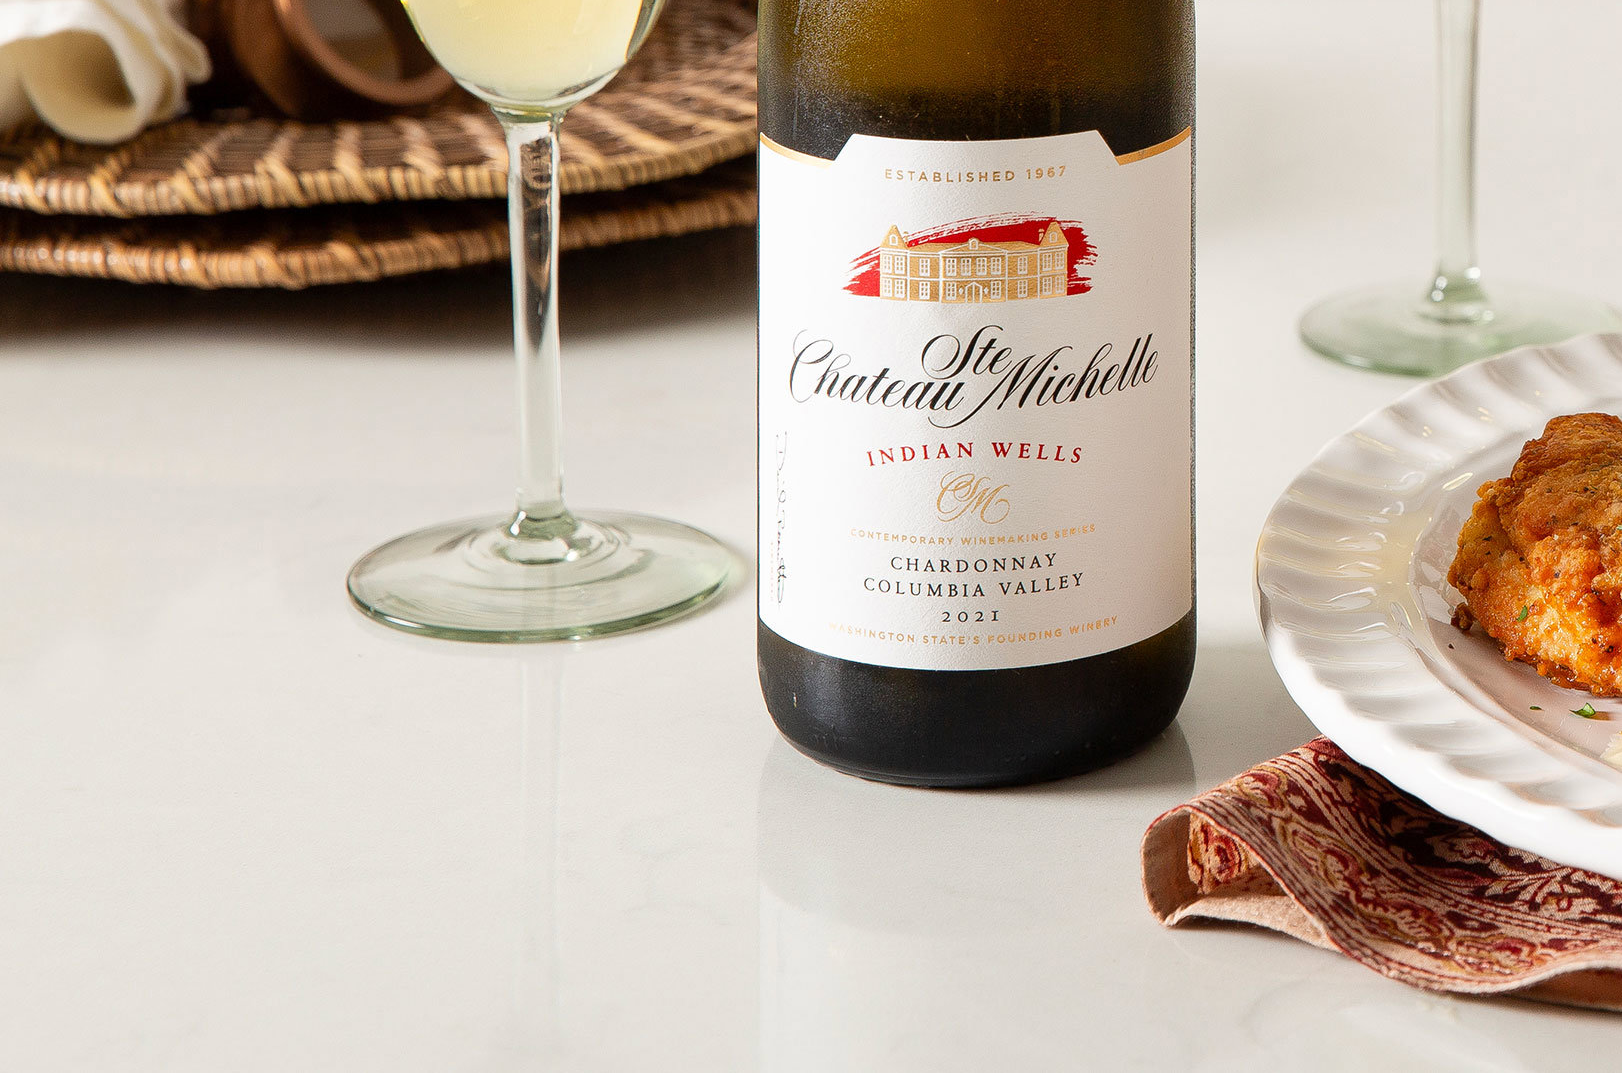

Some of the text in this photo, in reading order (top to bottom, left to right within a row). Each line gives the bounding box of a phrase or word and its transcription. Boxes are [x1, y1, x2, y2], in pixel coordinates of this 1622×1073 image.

[884, 165, 1067, 184] ESTABLISHED 1967
[921, 325, 1013, 379] Ste
[789, 329, 1159, 429] Chateau Michelle
[866, 441, 1084, 467] INDIAN WELLS
[850, 523, 1096, 546] CONTEMPORARY WINEMAKING SERIES
[890, 552, 1057, 573] CHARDONNAY
[863, 572, 1085, 598] COLUMBIA VALLEY
[941, 610, 1000, 623] 2021
[828, 615, 1119, 645] WASHINGTON STATE'S FOUNDING WINERY
